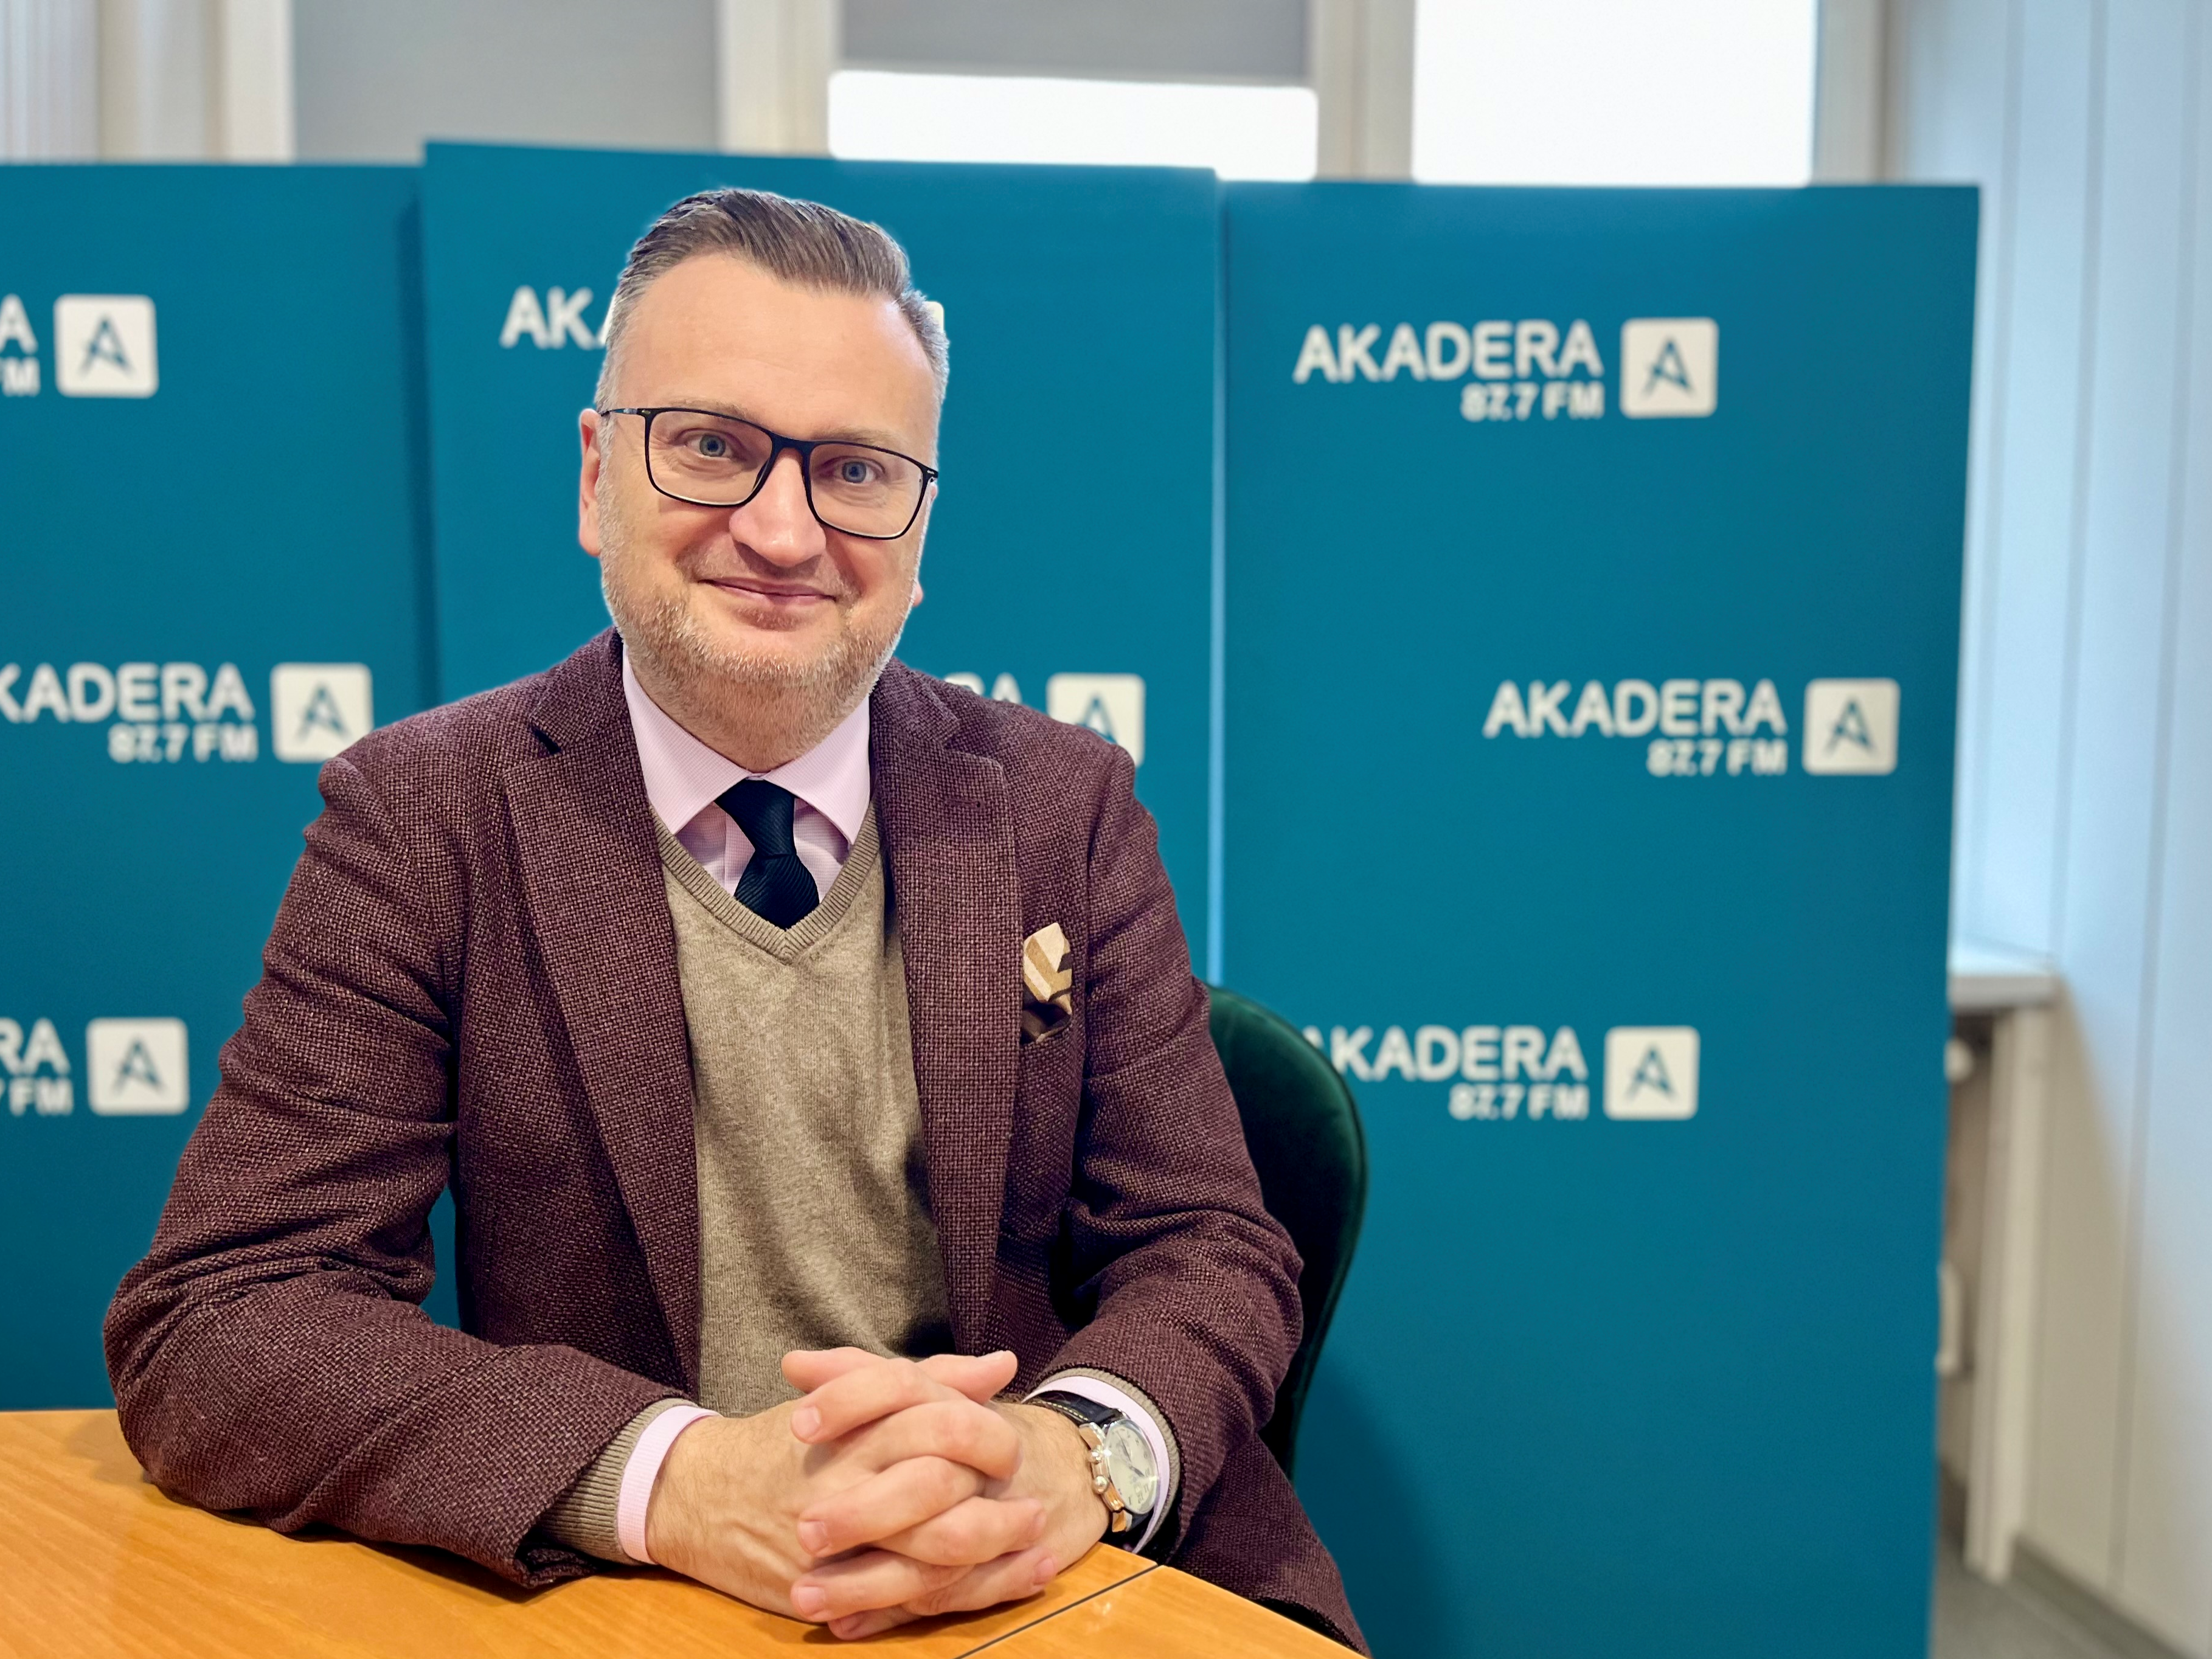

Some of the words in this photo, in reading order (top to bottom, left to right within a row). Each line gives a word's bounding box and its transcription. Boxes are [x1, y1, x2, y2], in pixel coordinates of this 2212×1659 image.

[500, 286, 617, 350] AK
[1293, 319, 1603, 383] AKADERA
[1541, 381, 1604, 420] FM
[1483, 679, 1787, 738] AKADERA
[193, 724, 258, 761] FM
[1727, 738, 1788, 775] FM
[1528, 1084, 1589, 1119] FM
